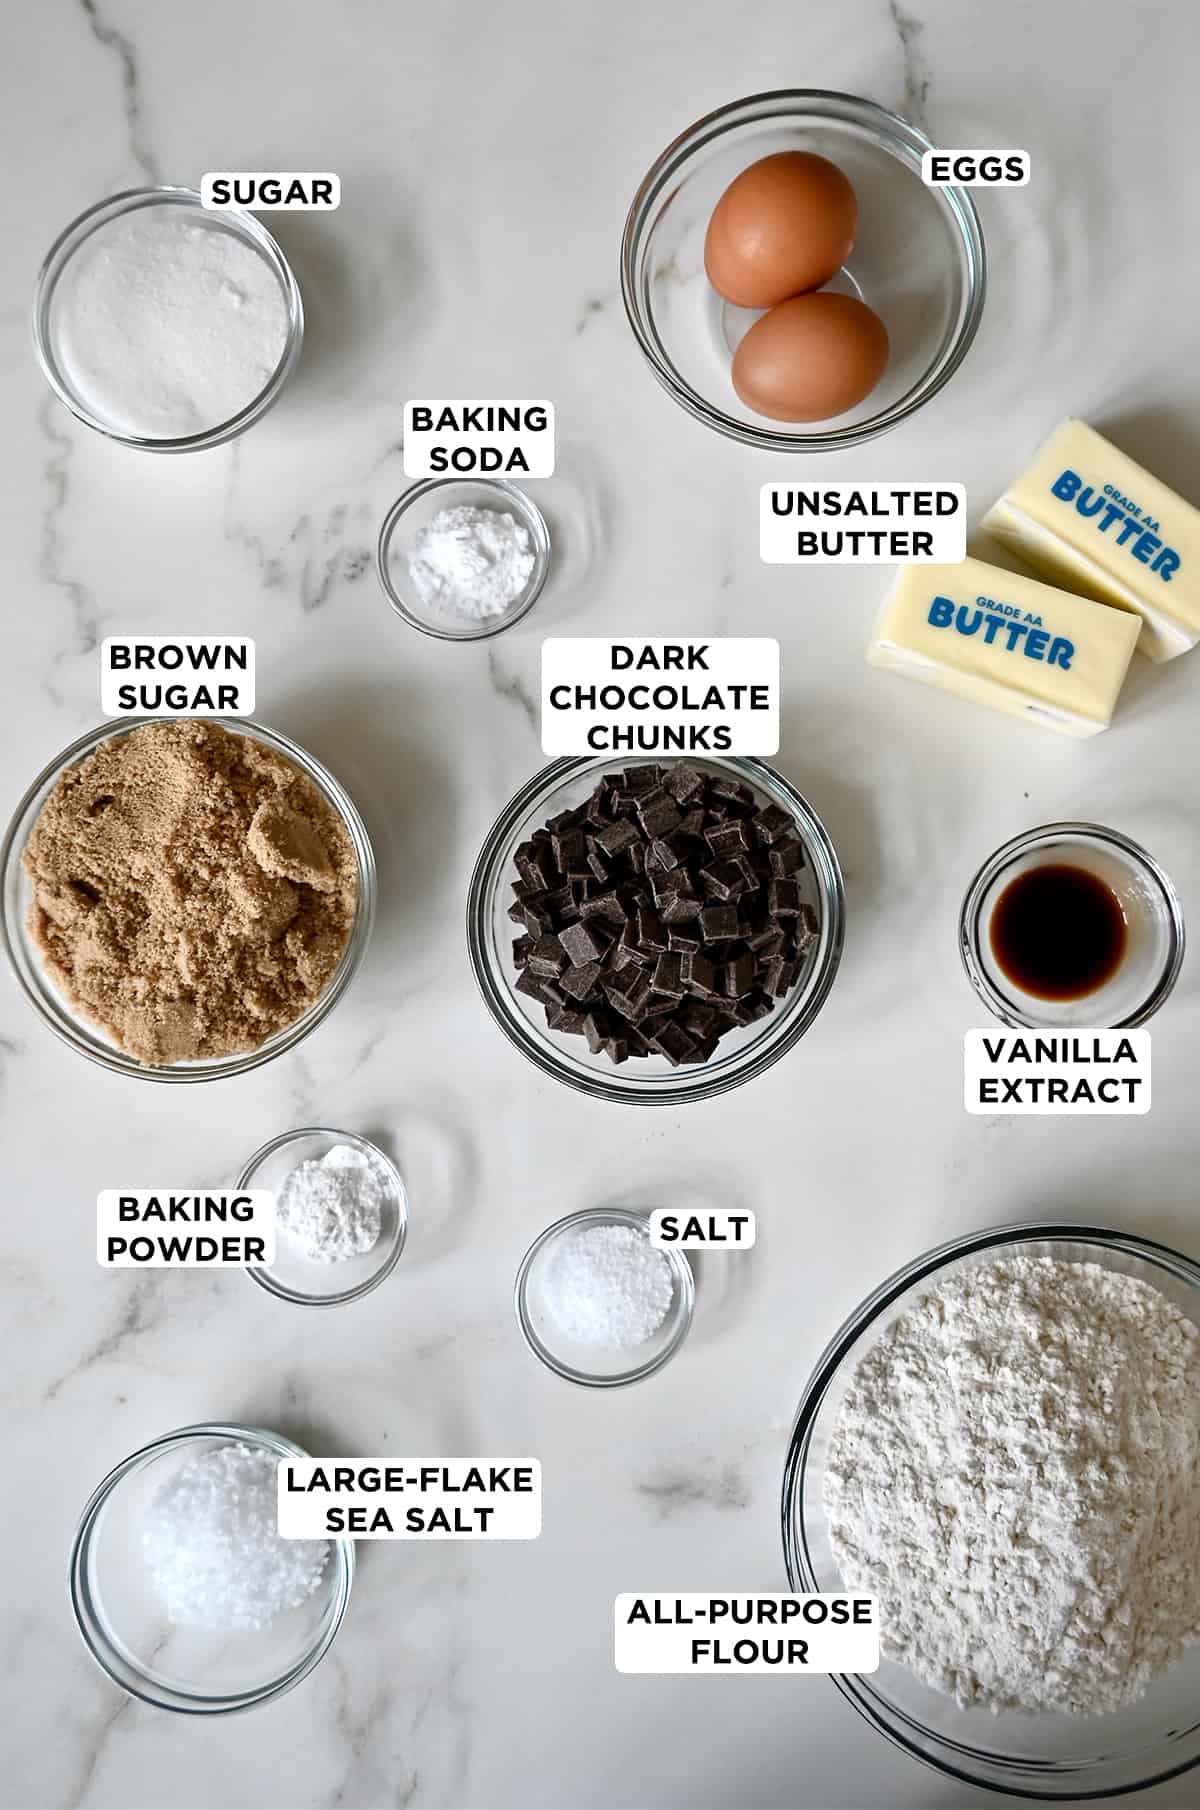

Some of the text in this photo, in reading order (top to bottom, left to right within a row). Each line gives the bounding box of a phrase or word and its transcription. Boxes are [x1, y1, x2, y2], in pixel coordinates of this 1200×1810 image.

[1051, 470, 1181, 582] BUTTER
[1103, 484, 1160, 531] GRADE AA
[927, 596, 1075, 670] BUTTER
[976, 596, 1043, 627] GRADE AA
